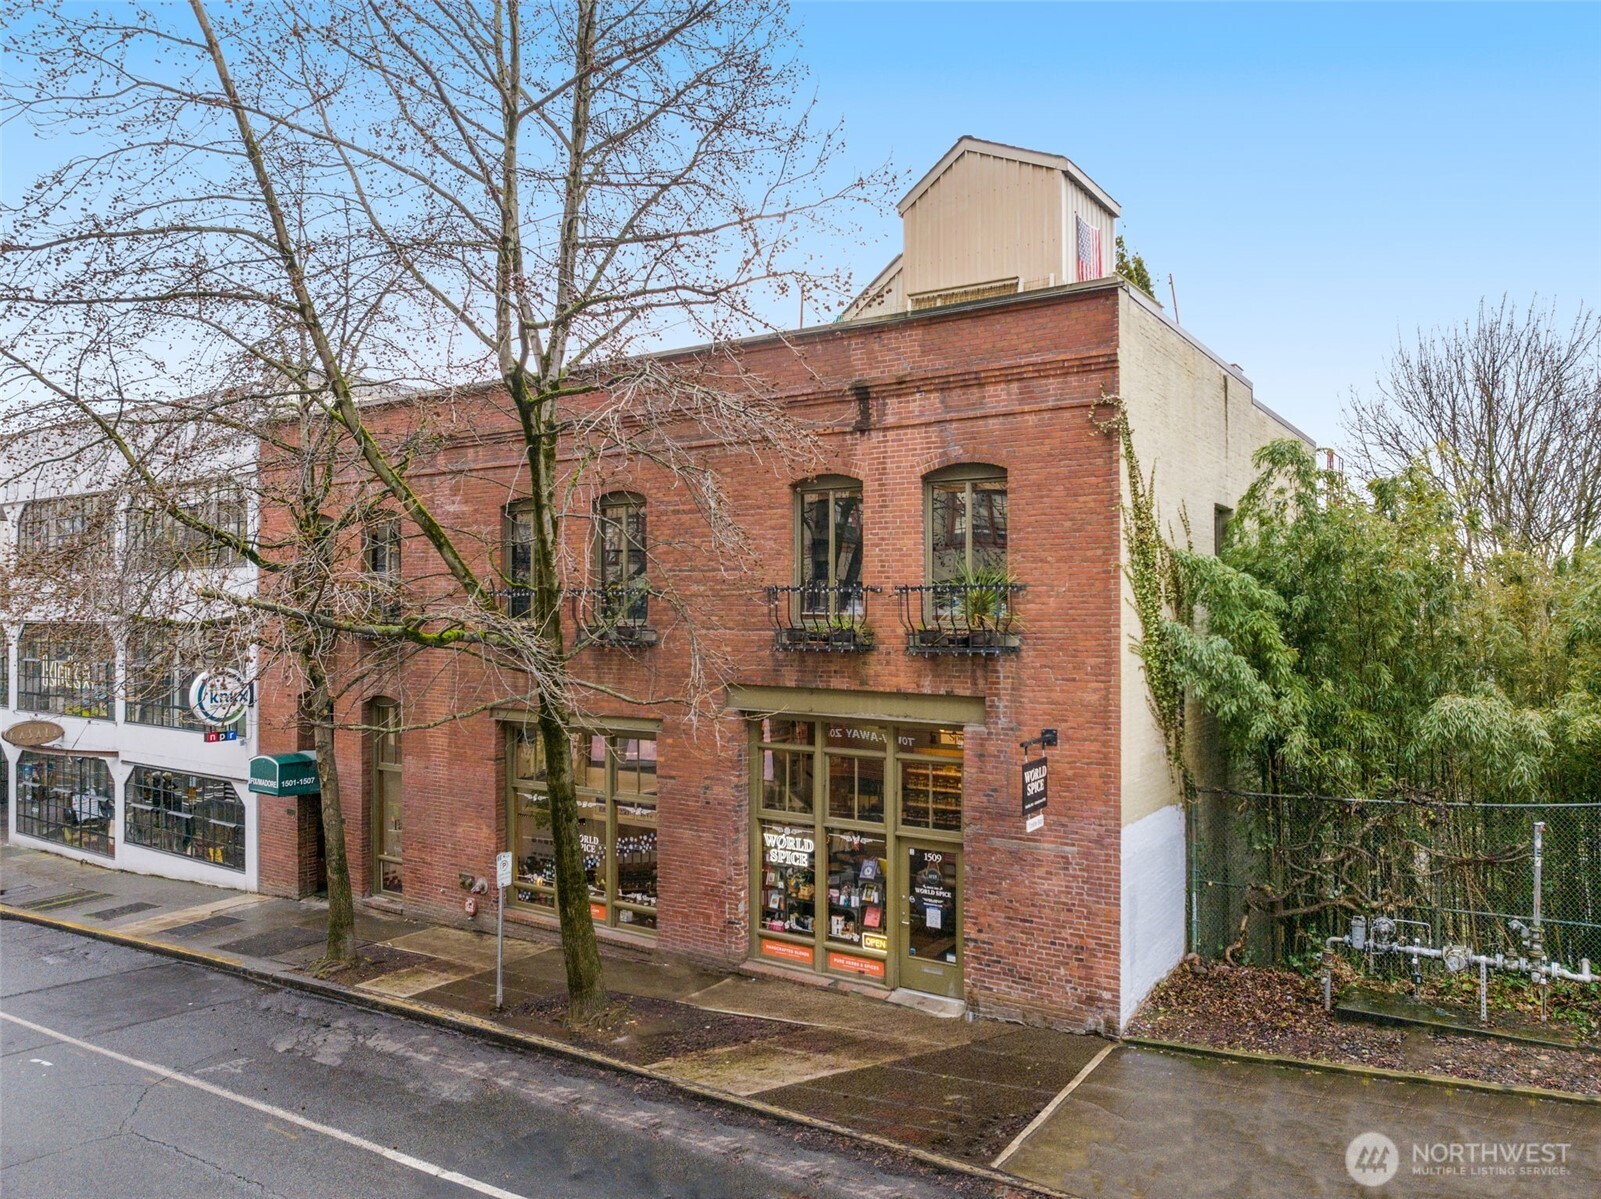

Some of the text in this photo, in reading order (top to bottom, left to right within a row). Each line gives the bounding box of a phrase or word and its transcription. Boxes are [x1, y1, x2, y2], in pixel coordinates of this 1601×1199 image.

[209, 732, 234, 741] npr
[1024, 765, 1047, 783] WORLD
[281, 777, 315, 788] 1501-1507
[1027, 778, 1044, 796] SPICE
[579, 834, 599, 845] ORLD
[769, 848, 809, 868] SPICE
[923, 852, 942, 863] 1509
[865, 936, 887, 949] OPEN
